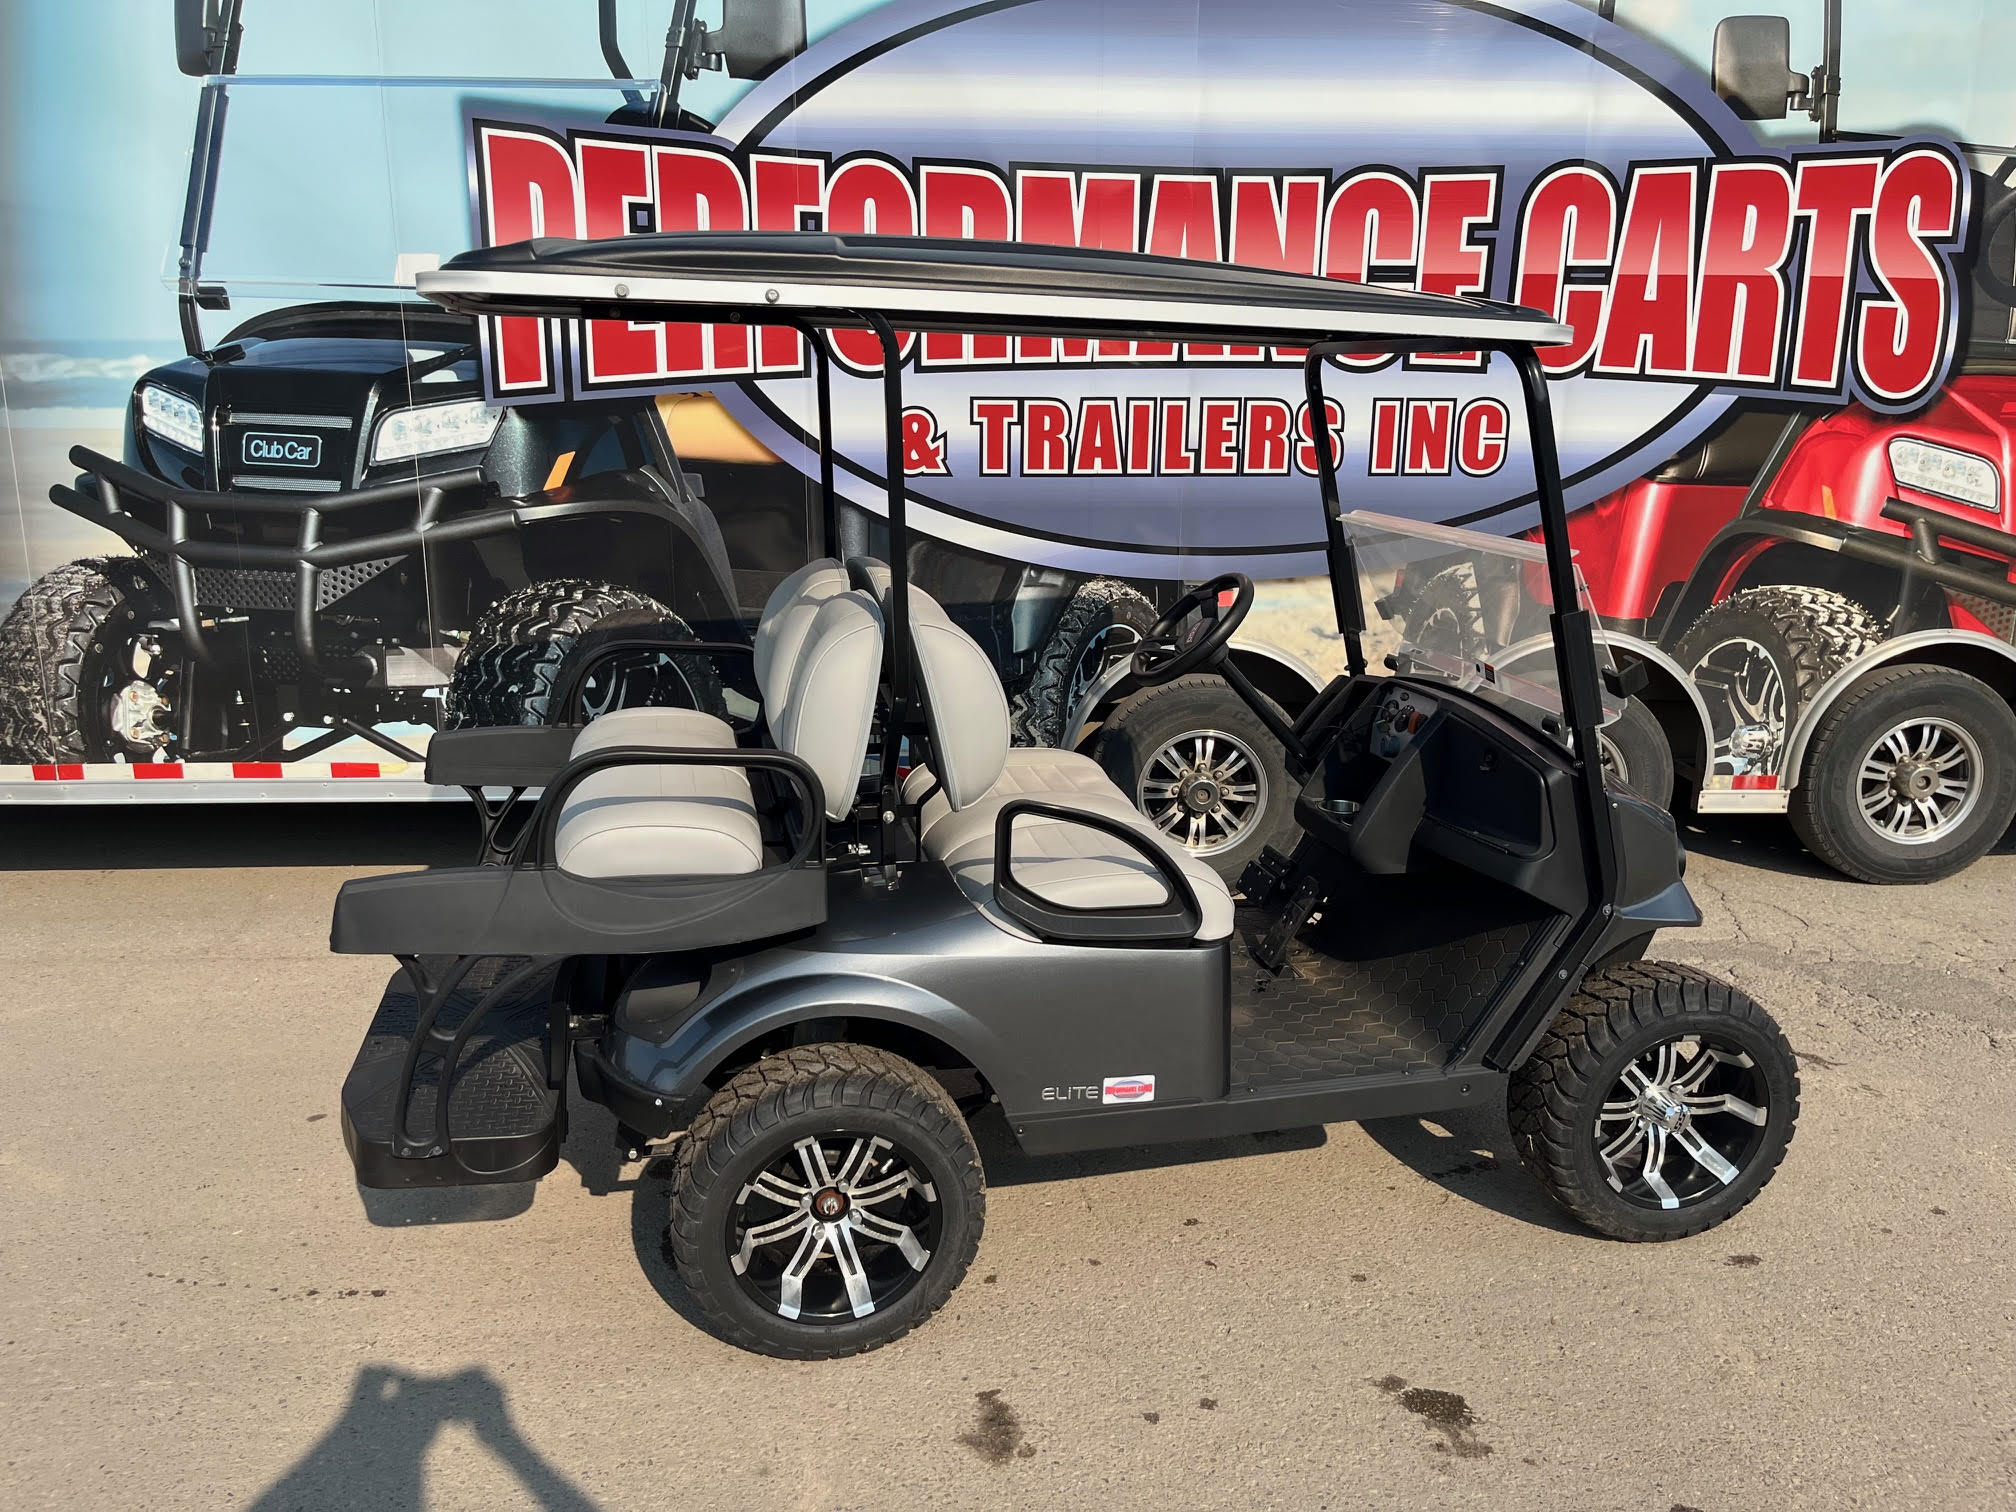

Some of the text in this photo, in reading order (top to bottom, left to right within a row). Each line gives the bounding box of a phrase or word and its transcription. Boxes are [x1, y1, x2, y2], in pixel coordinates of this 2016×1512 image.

[1513, 148, 1958, 400] CARTS
[250, 439, 313, 460] Club Car
[899, 396, 1512, 478] & TRAILERS INC
